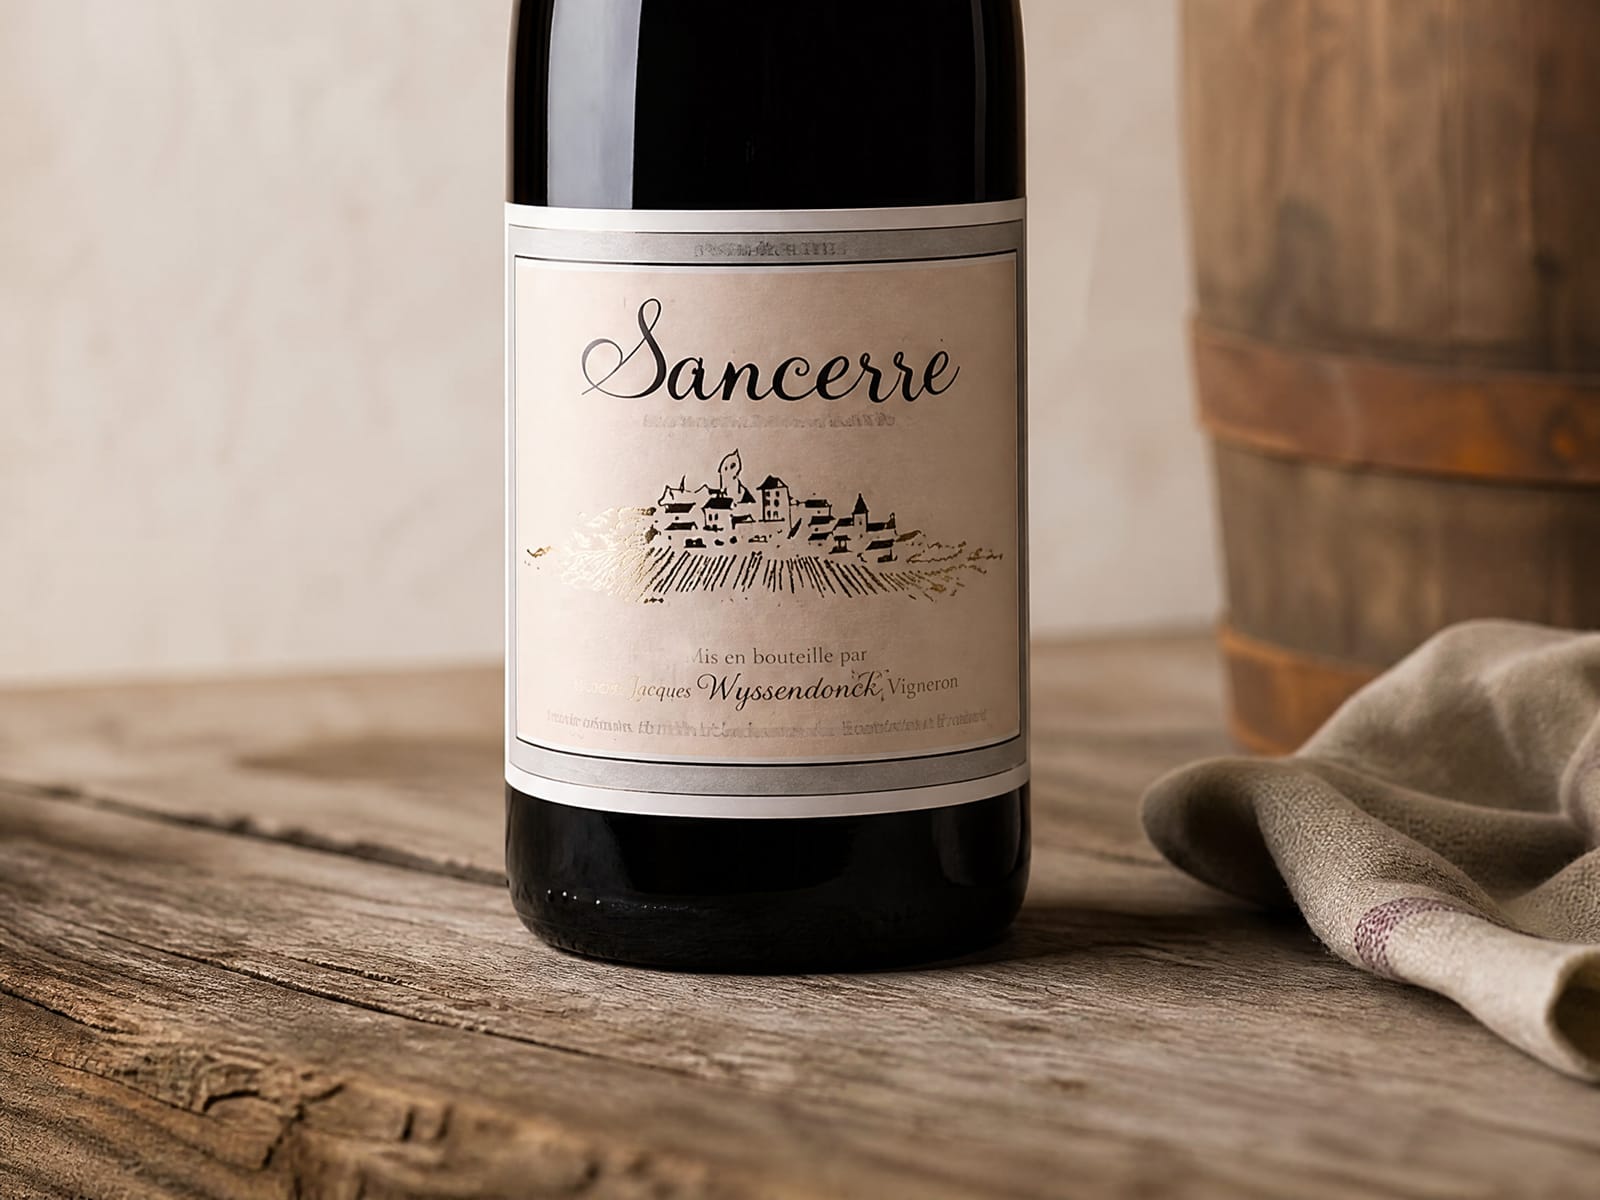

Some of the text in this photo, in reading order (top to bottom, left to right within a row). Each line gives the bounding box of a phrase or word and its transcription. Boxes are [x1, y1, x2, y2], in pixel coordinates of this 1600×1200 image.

[582, 298, 960, 402] Sancerre
[725, 654, 746, 665] en
[753, 647, 834, 666] bouteille
[840, 650, 867, 667] par
[888, 676, 958, 699] Vigneron
